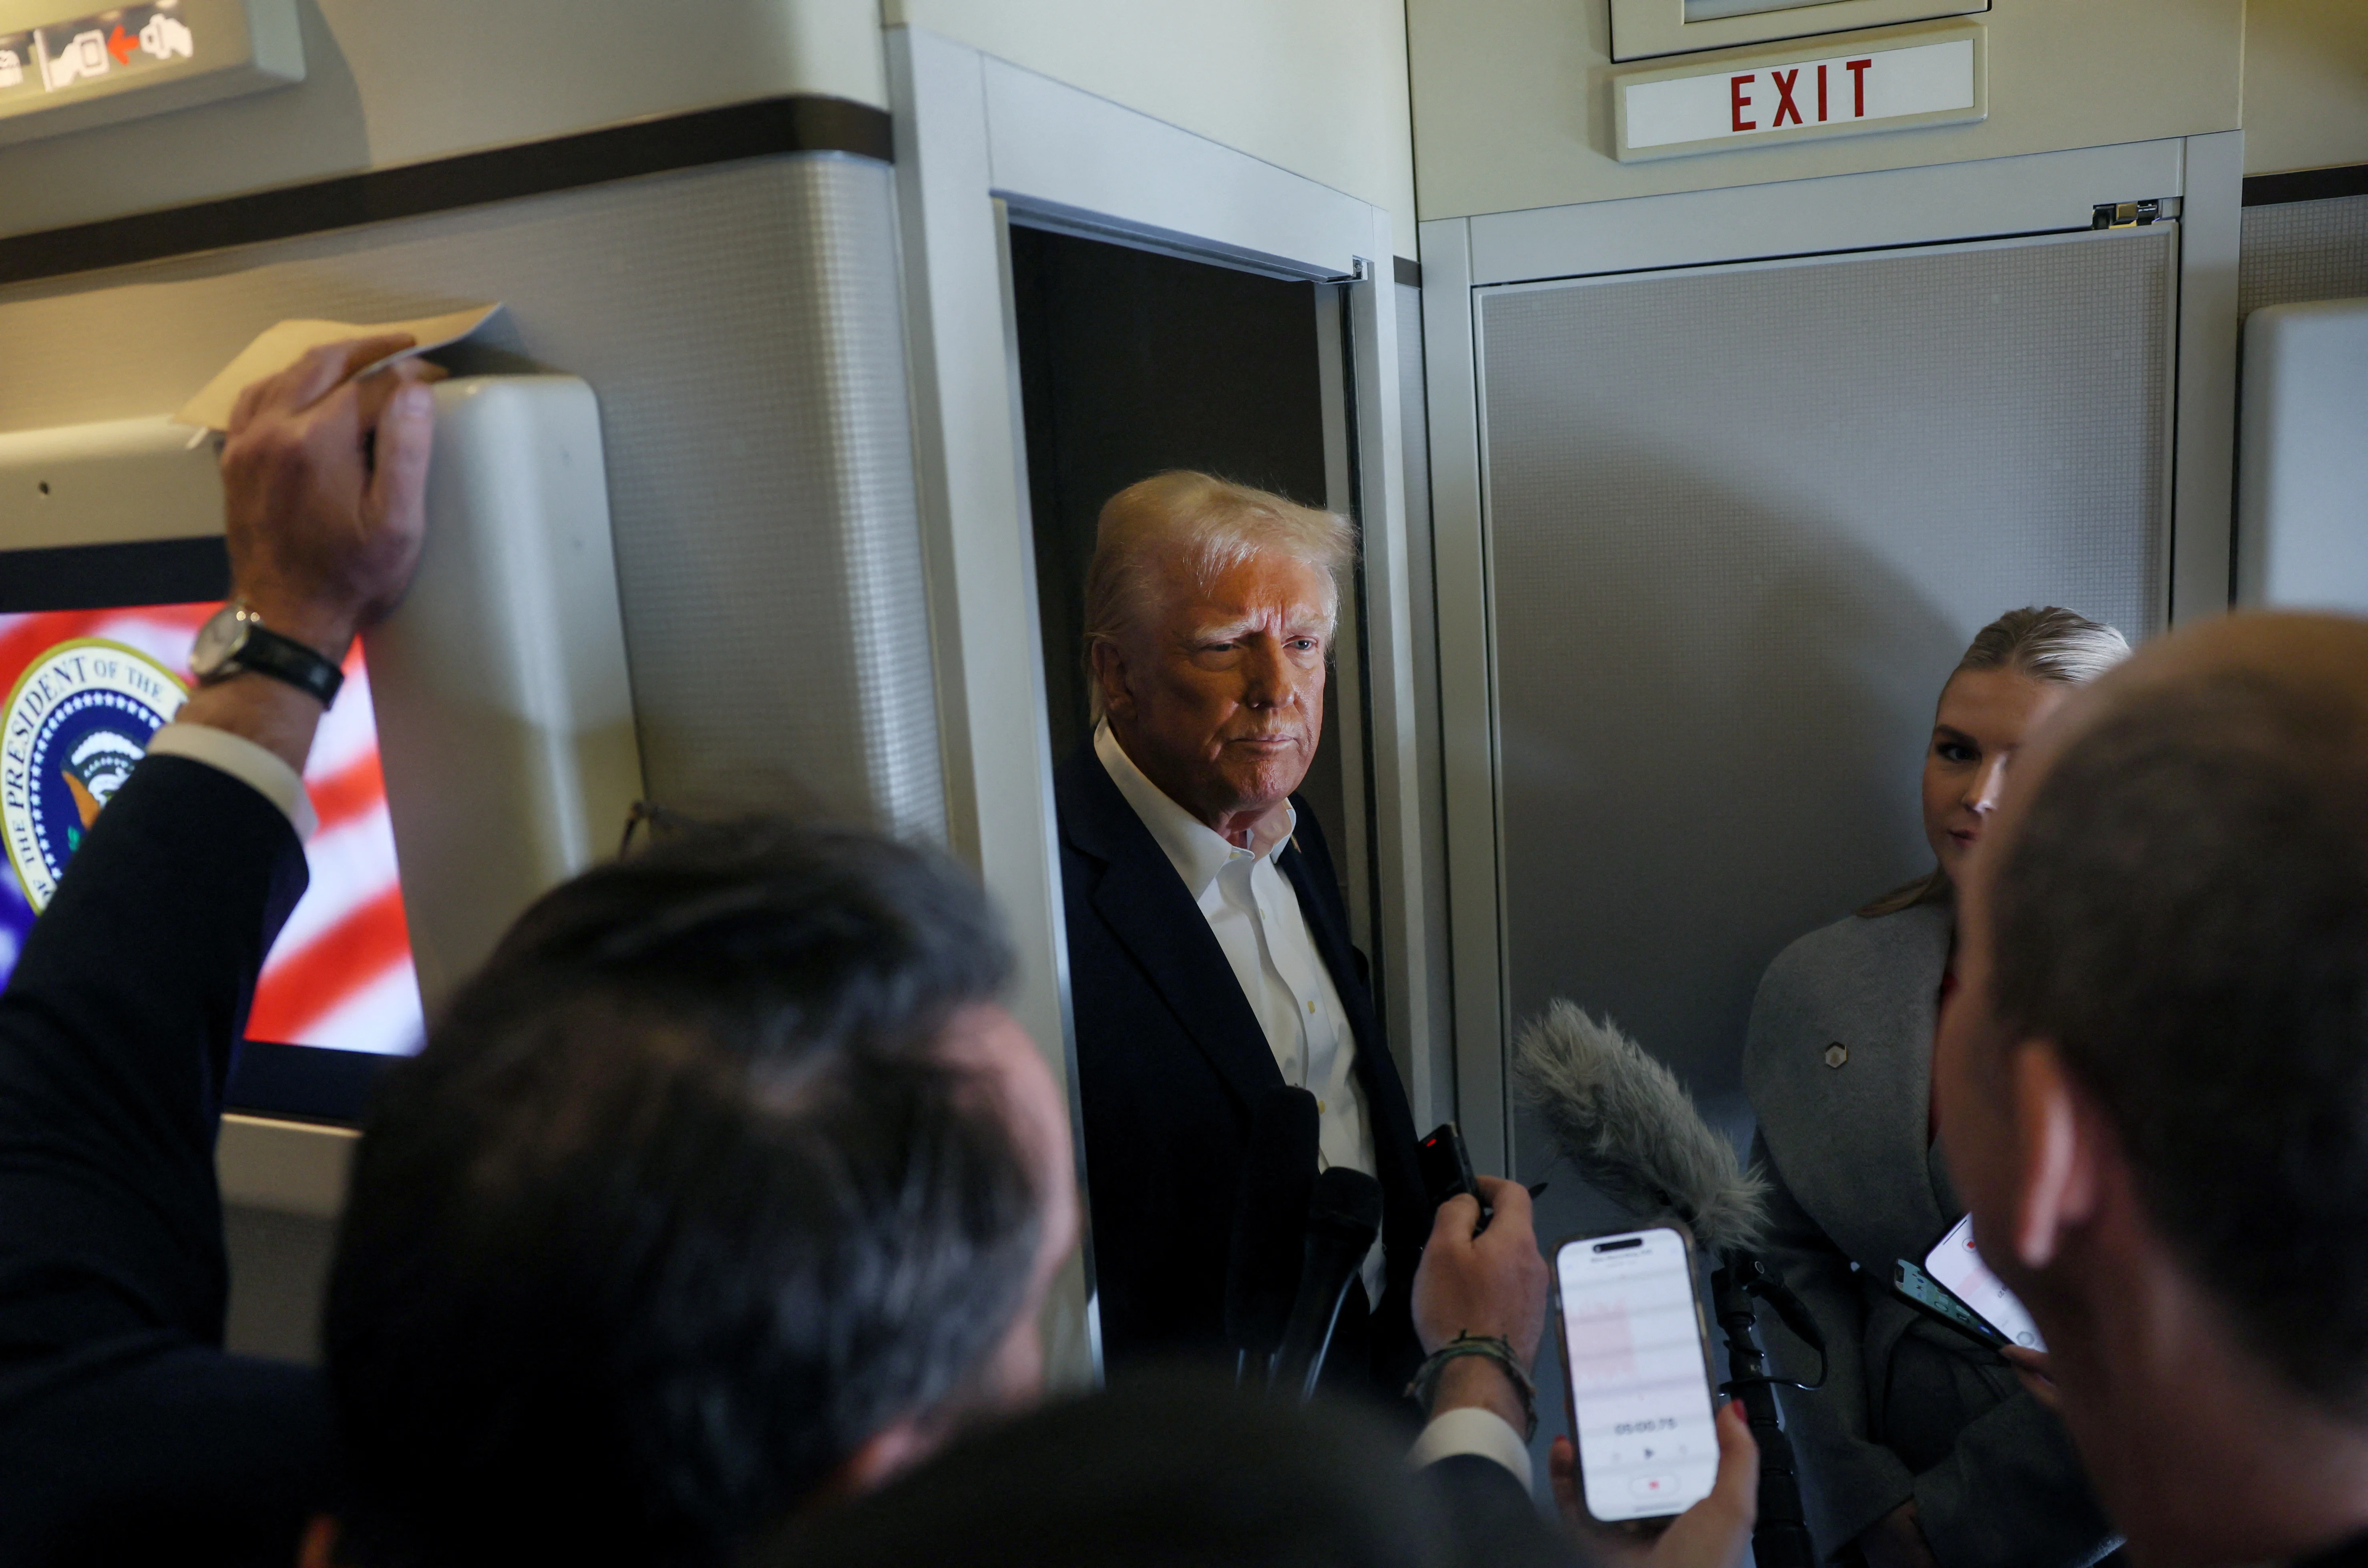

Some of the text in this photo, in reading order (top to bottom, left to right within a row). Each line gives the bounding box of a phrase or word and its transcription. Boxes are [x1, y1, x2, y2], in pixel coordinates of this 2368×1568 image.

[1731, 59, 1871, 132] EXIT
[94, 659, 118, 679] OF
[126, 667, 164, 702] THE
[7, 655, 86, 809] PRESIDENT
[12, 820, 35, 868] THE
